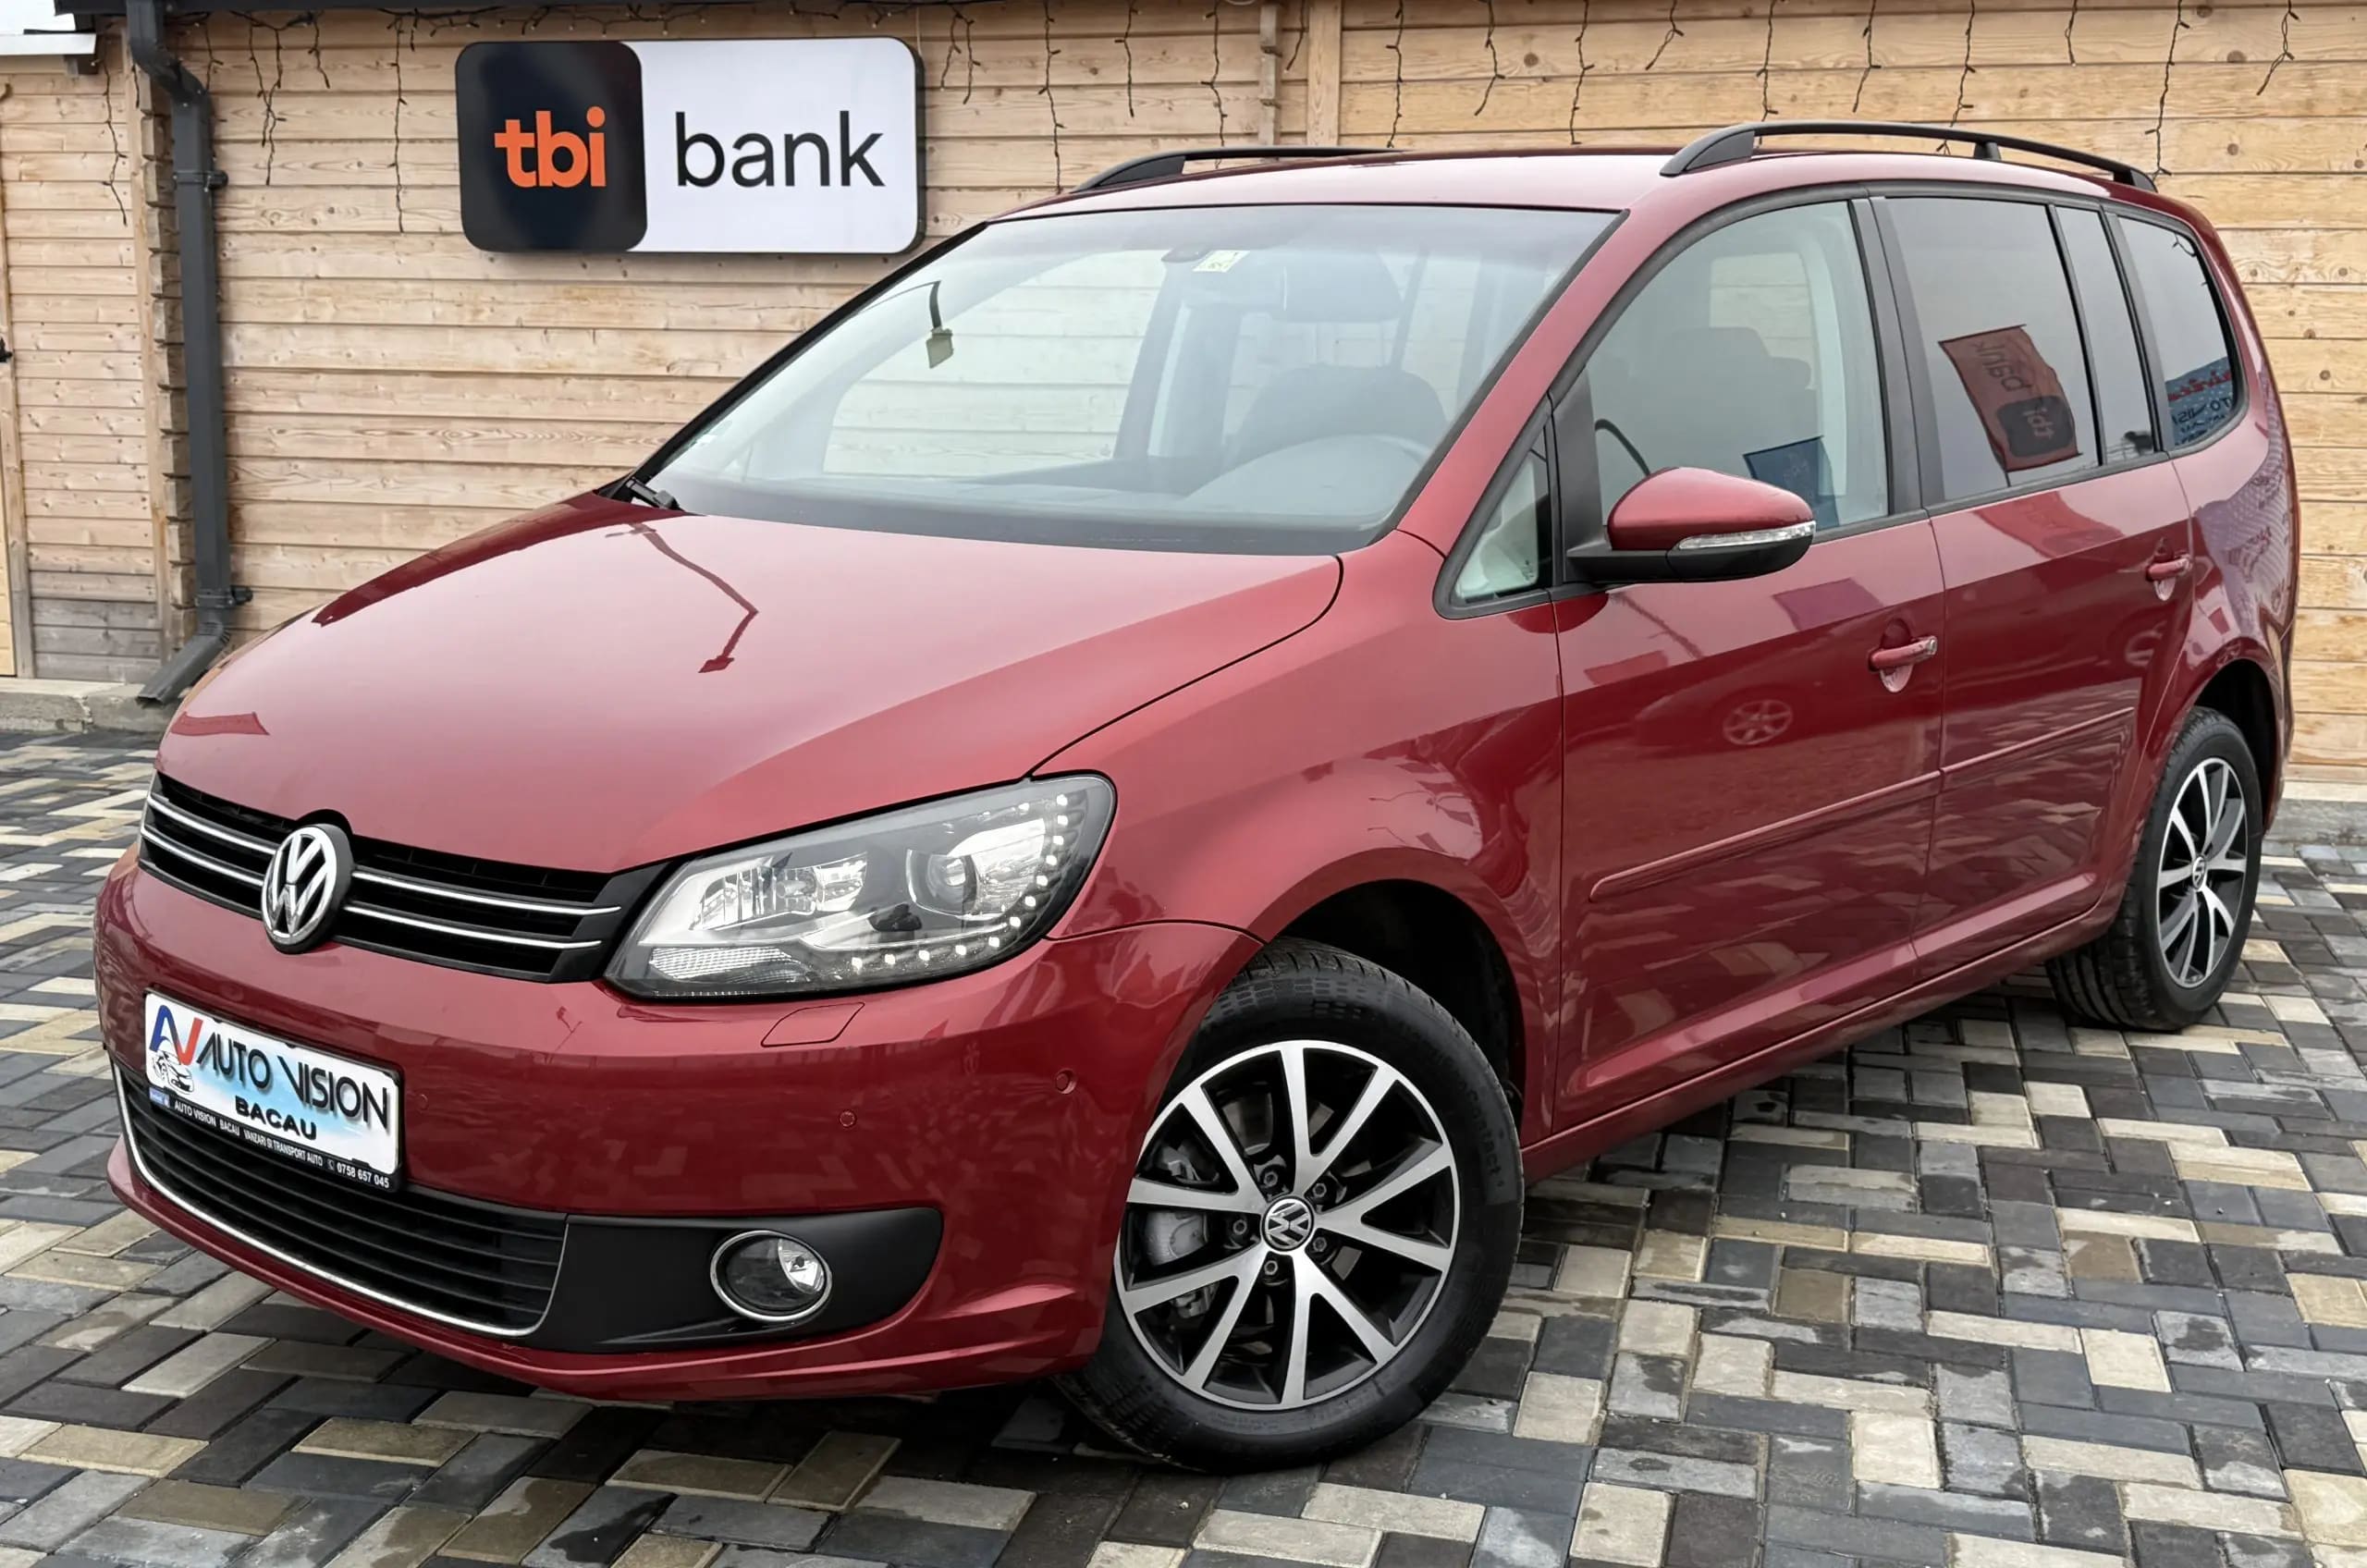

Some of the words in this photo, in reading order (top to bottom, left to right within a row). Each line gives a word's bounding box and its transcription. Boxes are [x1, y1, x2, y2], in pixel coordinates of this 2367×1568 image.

[494, 106, 606, 188] tbi
[676, 110, 886, 187] bank
[196, 1032, 272, 1089] AUTO
[277, 1056, 387, 1130] VISION
[235, 1096, 317, 1141] BACAU
[175, 1100, 193, 1117] AUTO
[193, 1109, 216, 1128] VISION
[220, 1120, 240, 1136] BACAU
[273, 1140, 306, 1161] TRANSPORT
[307, 1152, 324, 1167] AUTO
[337, 1162, 356, 1179] 0758
[358, 1168, 373, 1183] 657
[374, 1173, 390, 1189] 045
